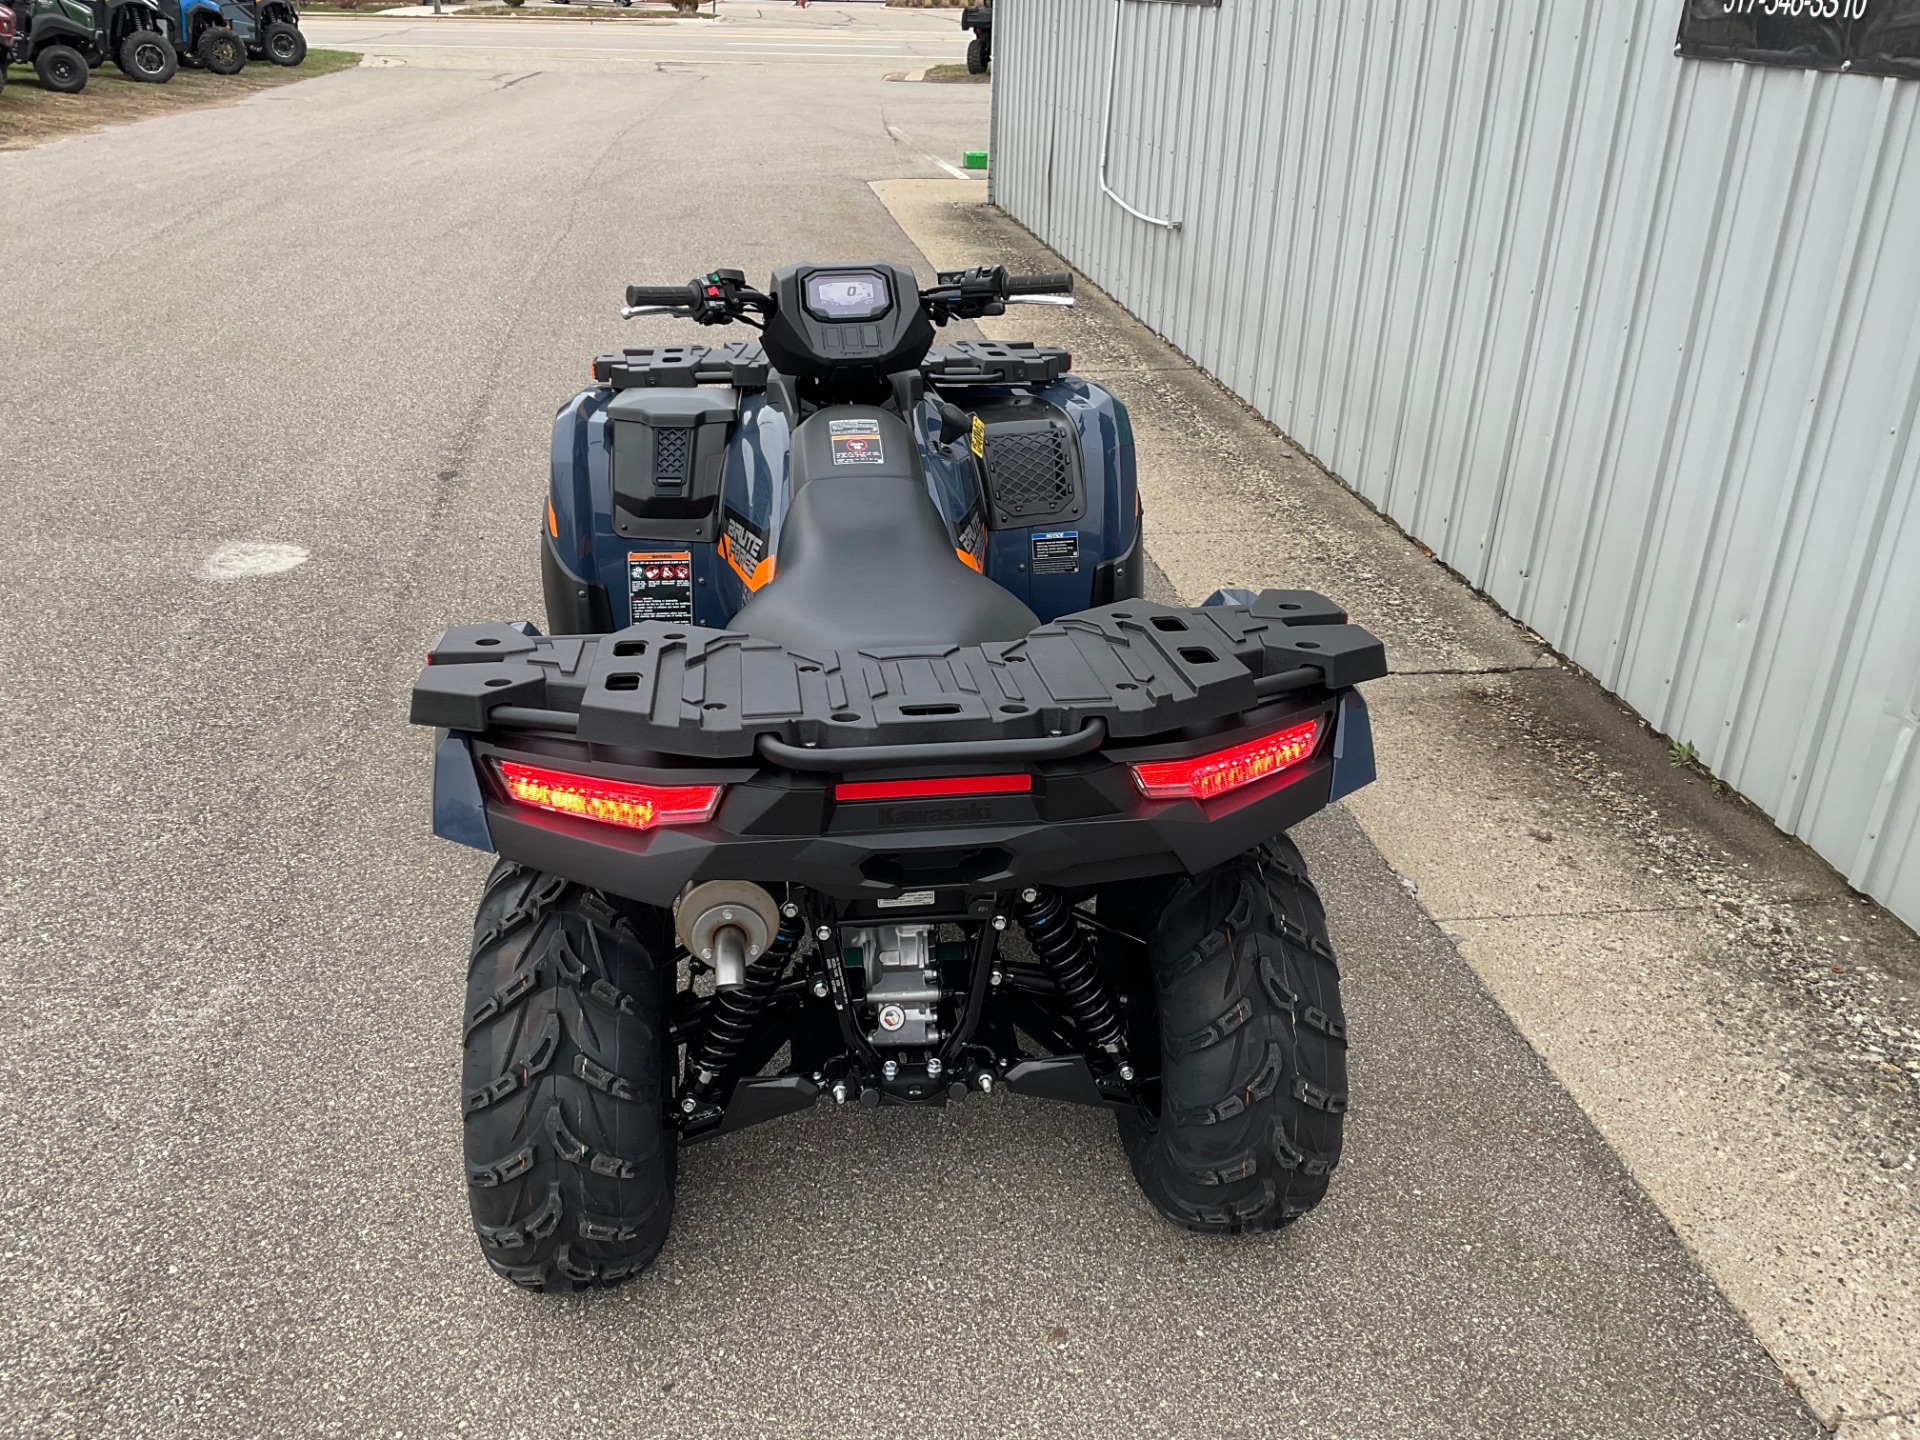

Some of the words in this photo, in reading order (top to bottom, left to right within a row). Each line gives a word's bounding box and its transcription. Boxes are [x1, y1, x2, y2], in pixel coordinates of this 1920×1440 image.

[727, 518, 763, 557] BRUTE
[729, 541, 758, 578] FORCE
[878, 802, 991, 825] Kawasaki
